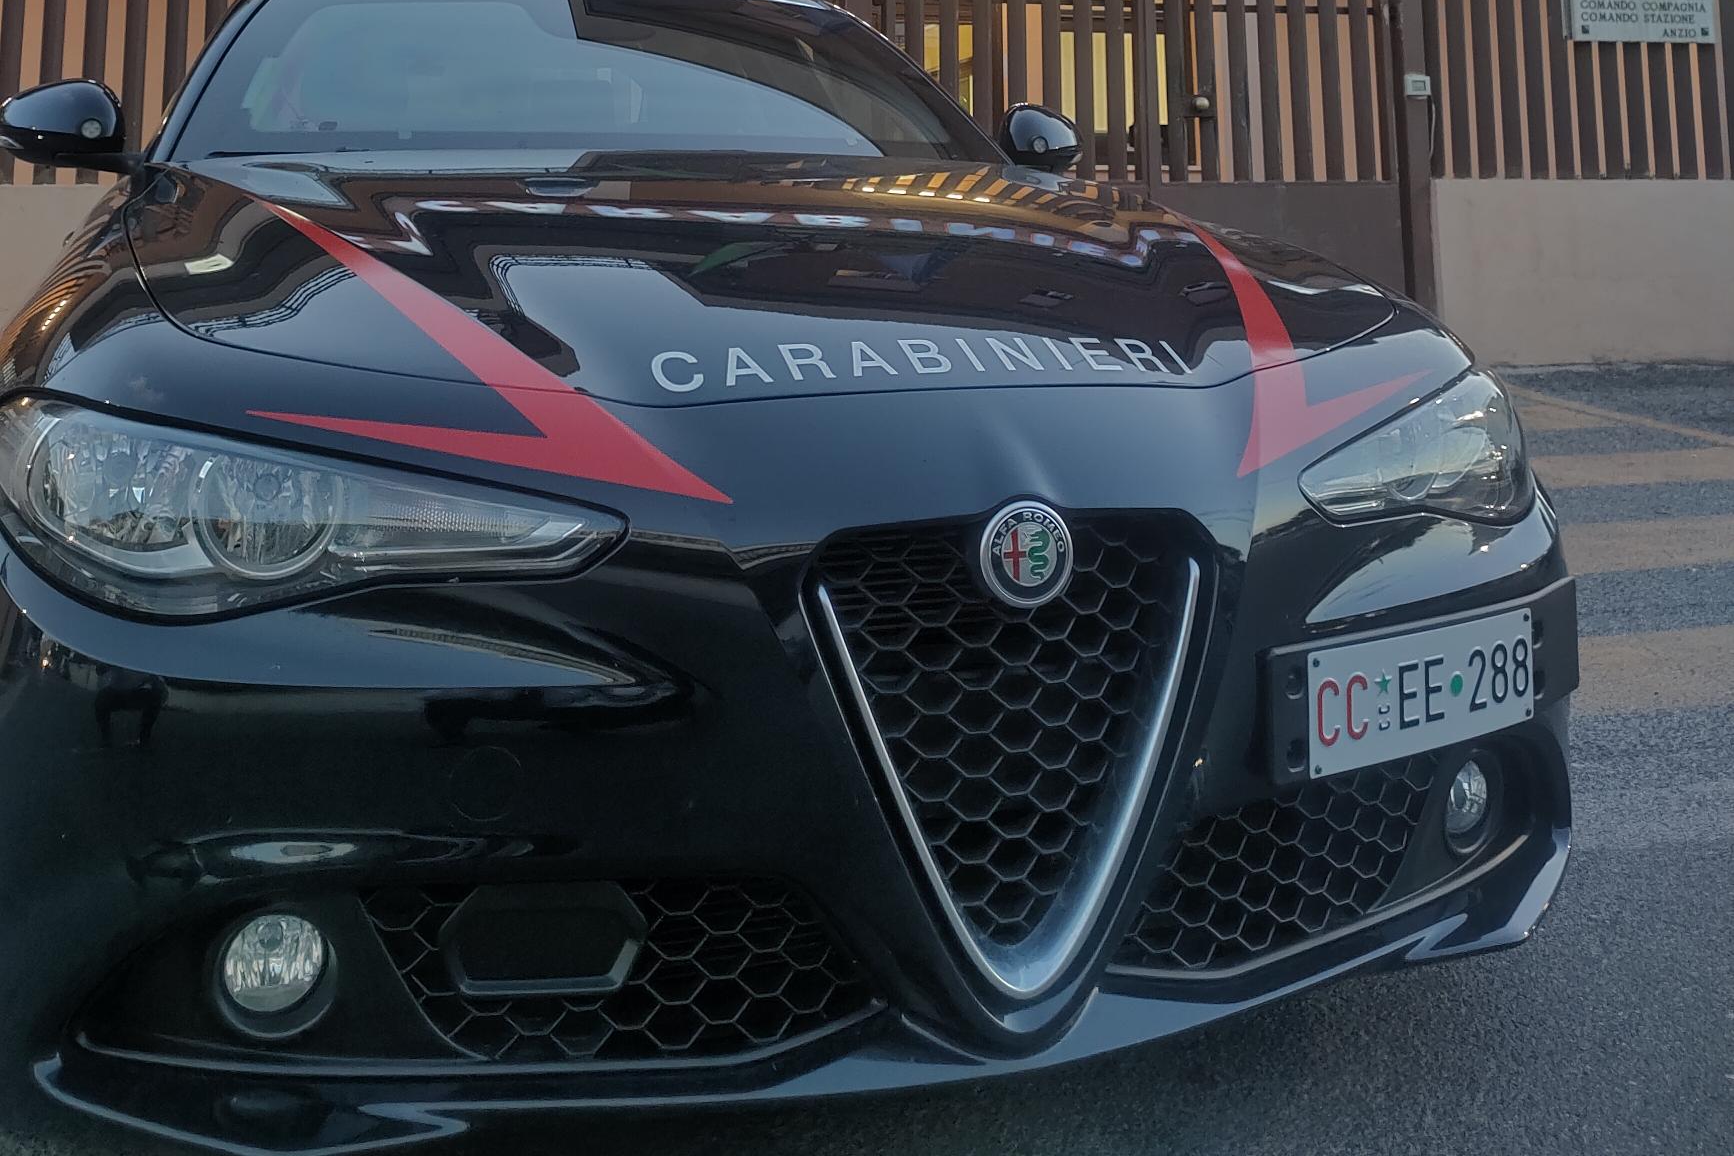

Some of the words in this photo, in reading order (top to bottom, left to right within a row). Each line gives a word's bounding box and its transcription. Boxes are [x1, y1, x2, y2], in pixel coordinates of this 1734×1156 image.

[1580, 0, 1637, 11] COMANDO
[1643, 1, 1706, 13] COMPAGNIA
[1581, 12, 1639, 23] COMANDO
[1644, 14, 1695, 24] STAZIONE
[1662, 28, 1697, 38] ANZIO
[651, 337, 1193, 393] CARABINIERI
[992, 518, 1018, 556] ALFA
[1022, 511, 1065, 553] ROMEO
[1317, 672, 1369, 747] CC
[1398, 656, 1446, 730] EE
[1468, 635, 1530, 712] 288
